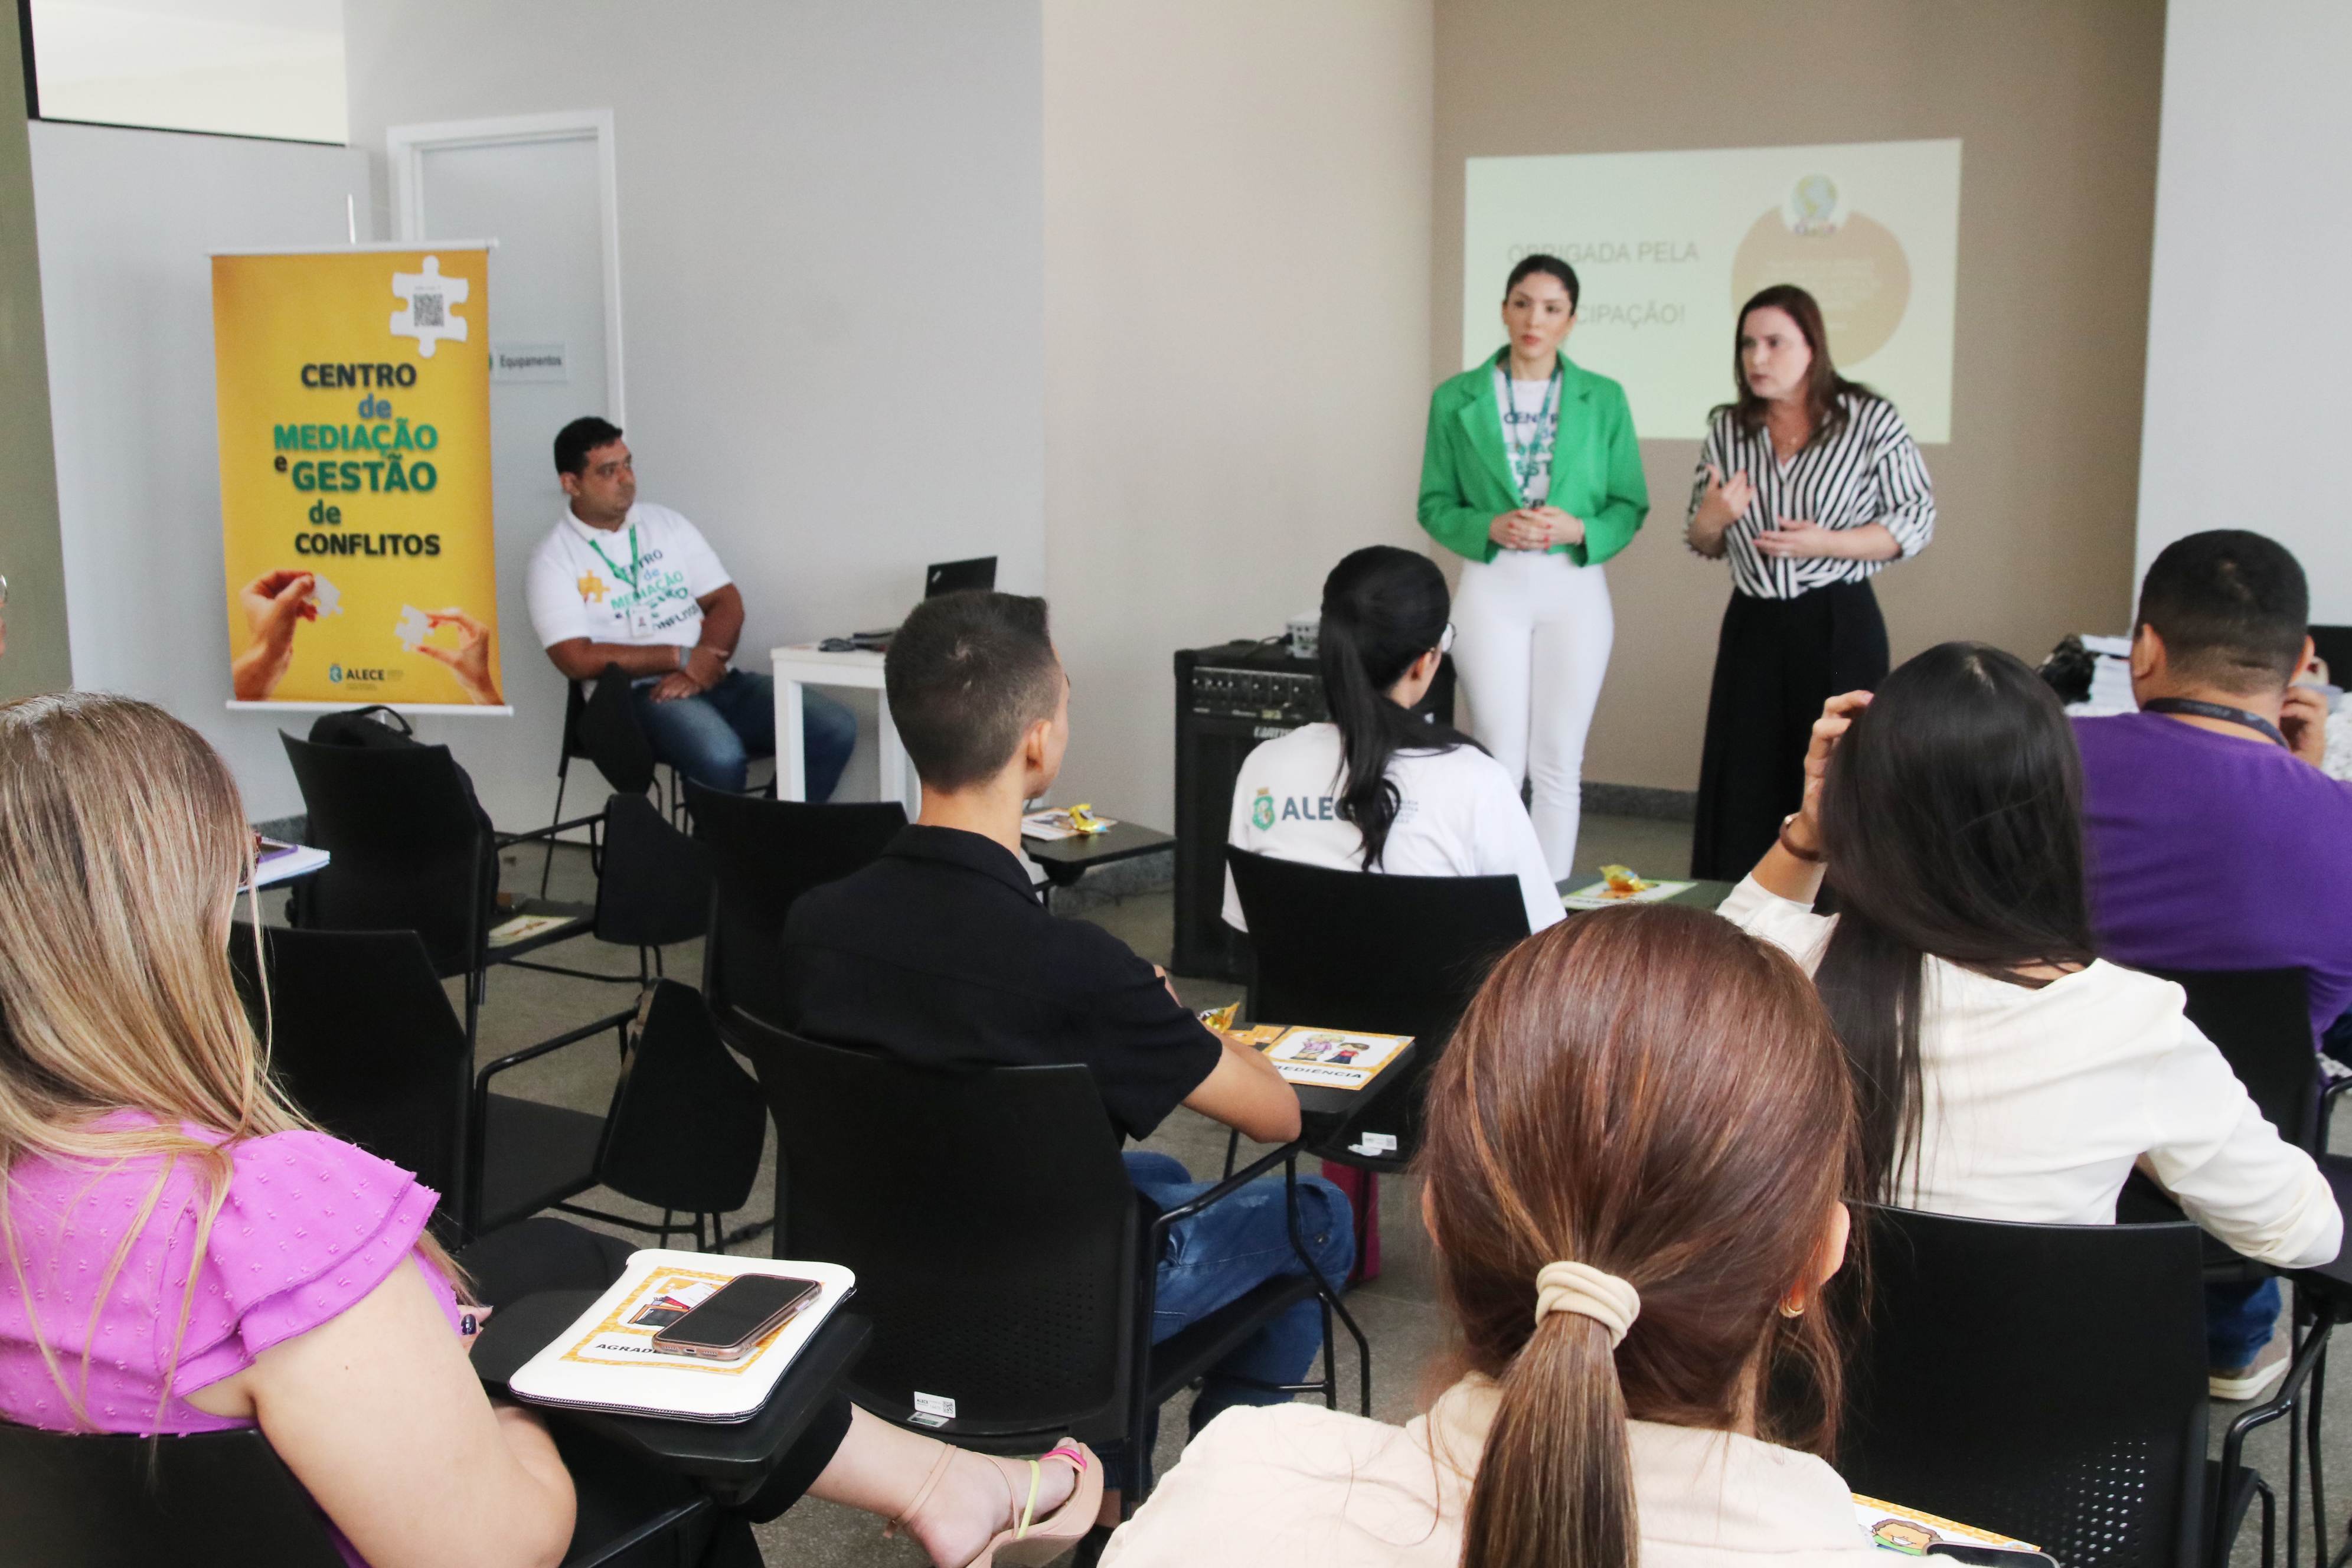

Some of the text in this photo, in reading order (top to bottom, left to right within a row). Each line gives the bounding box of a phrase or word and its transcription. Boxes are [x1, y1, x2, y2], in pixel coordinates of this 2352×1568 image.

[1637, 241, 1700, 262] PELA
[300, 362, 417, 388] CENTRO
[499, 355, 561, 370] Equipamentos
[357, 393, 392, 419] de
[273, 417, 438, 456] MEDIAÇÃO
[274, 453, 437, 492] e GESTÃO
[308, 499, 341, 524] de
[295, 533, 440, 556] CONFLITOS
[346, 668, 384, 680] ALECE
